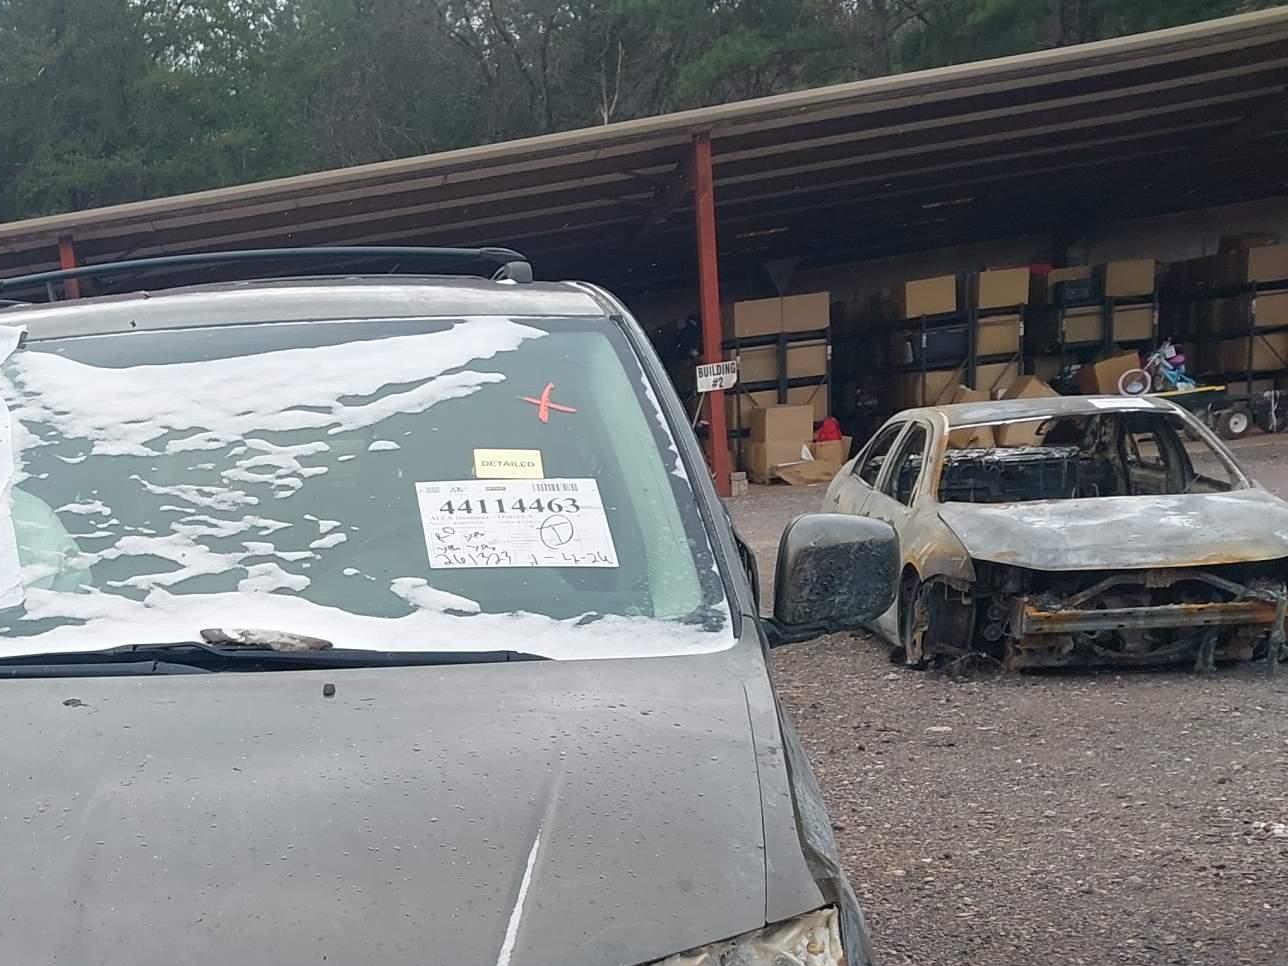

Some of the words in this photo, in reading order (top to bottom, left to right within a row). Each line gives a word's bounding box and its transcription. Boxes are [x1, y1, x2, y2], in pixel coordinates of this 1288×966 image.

[698, 362, 736, 378] BUILDING
[712, 377, 724, 388] #2
[481, 460, 535, 468] DETAILED
[439, 497, 580, 514] 44114463
